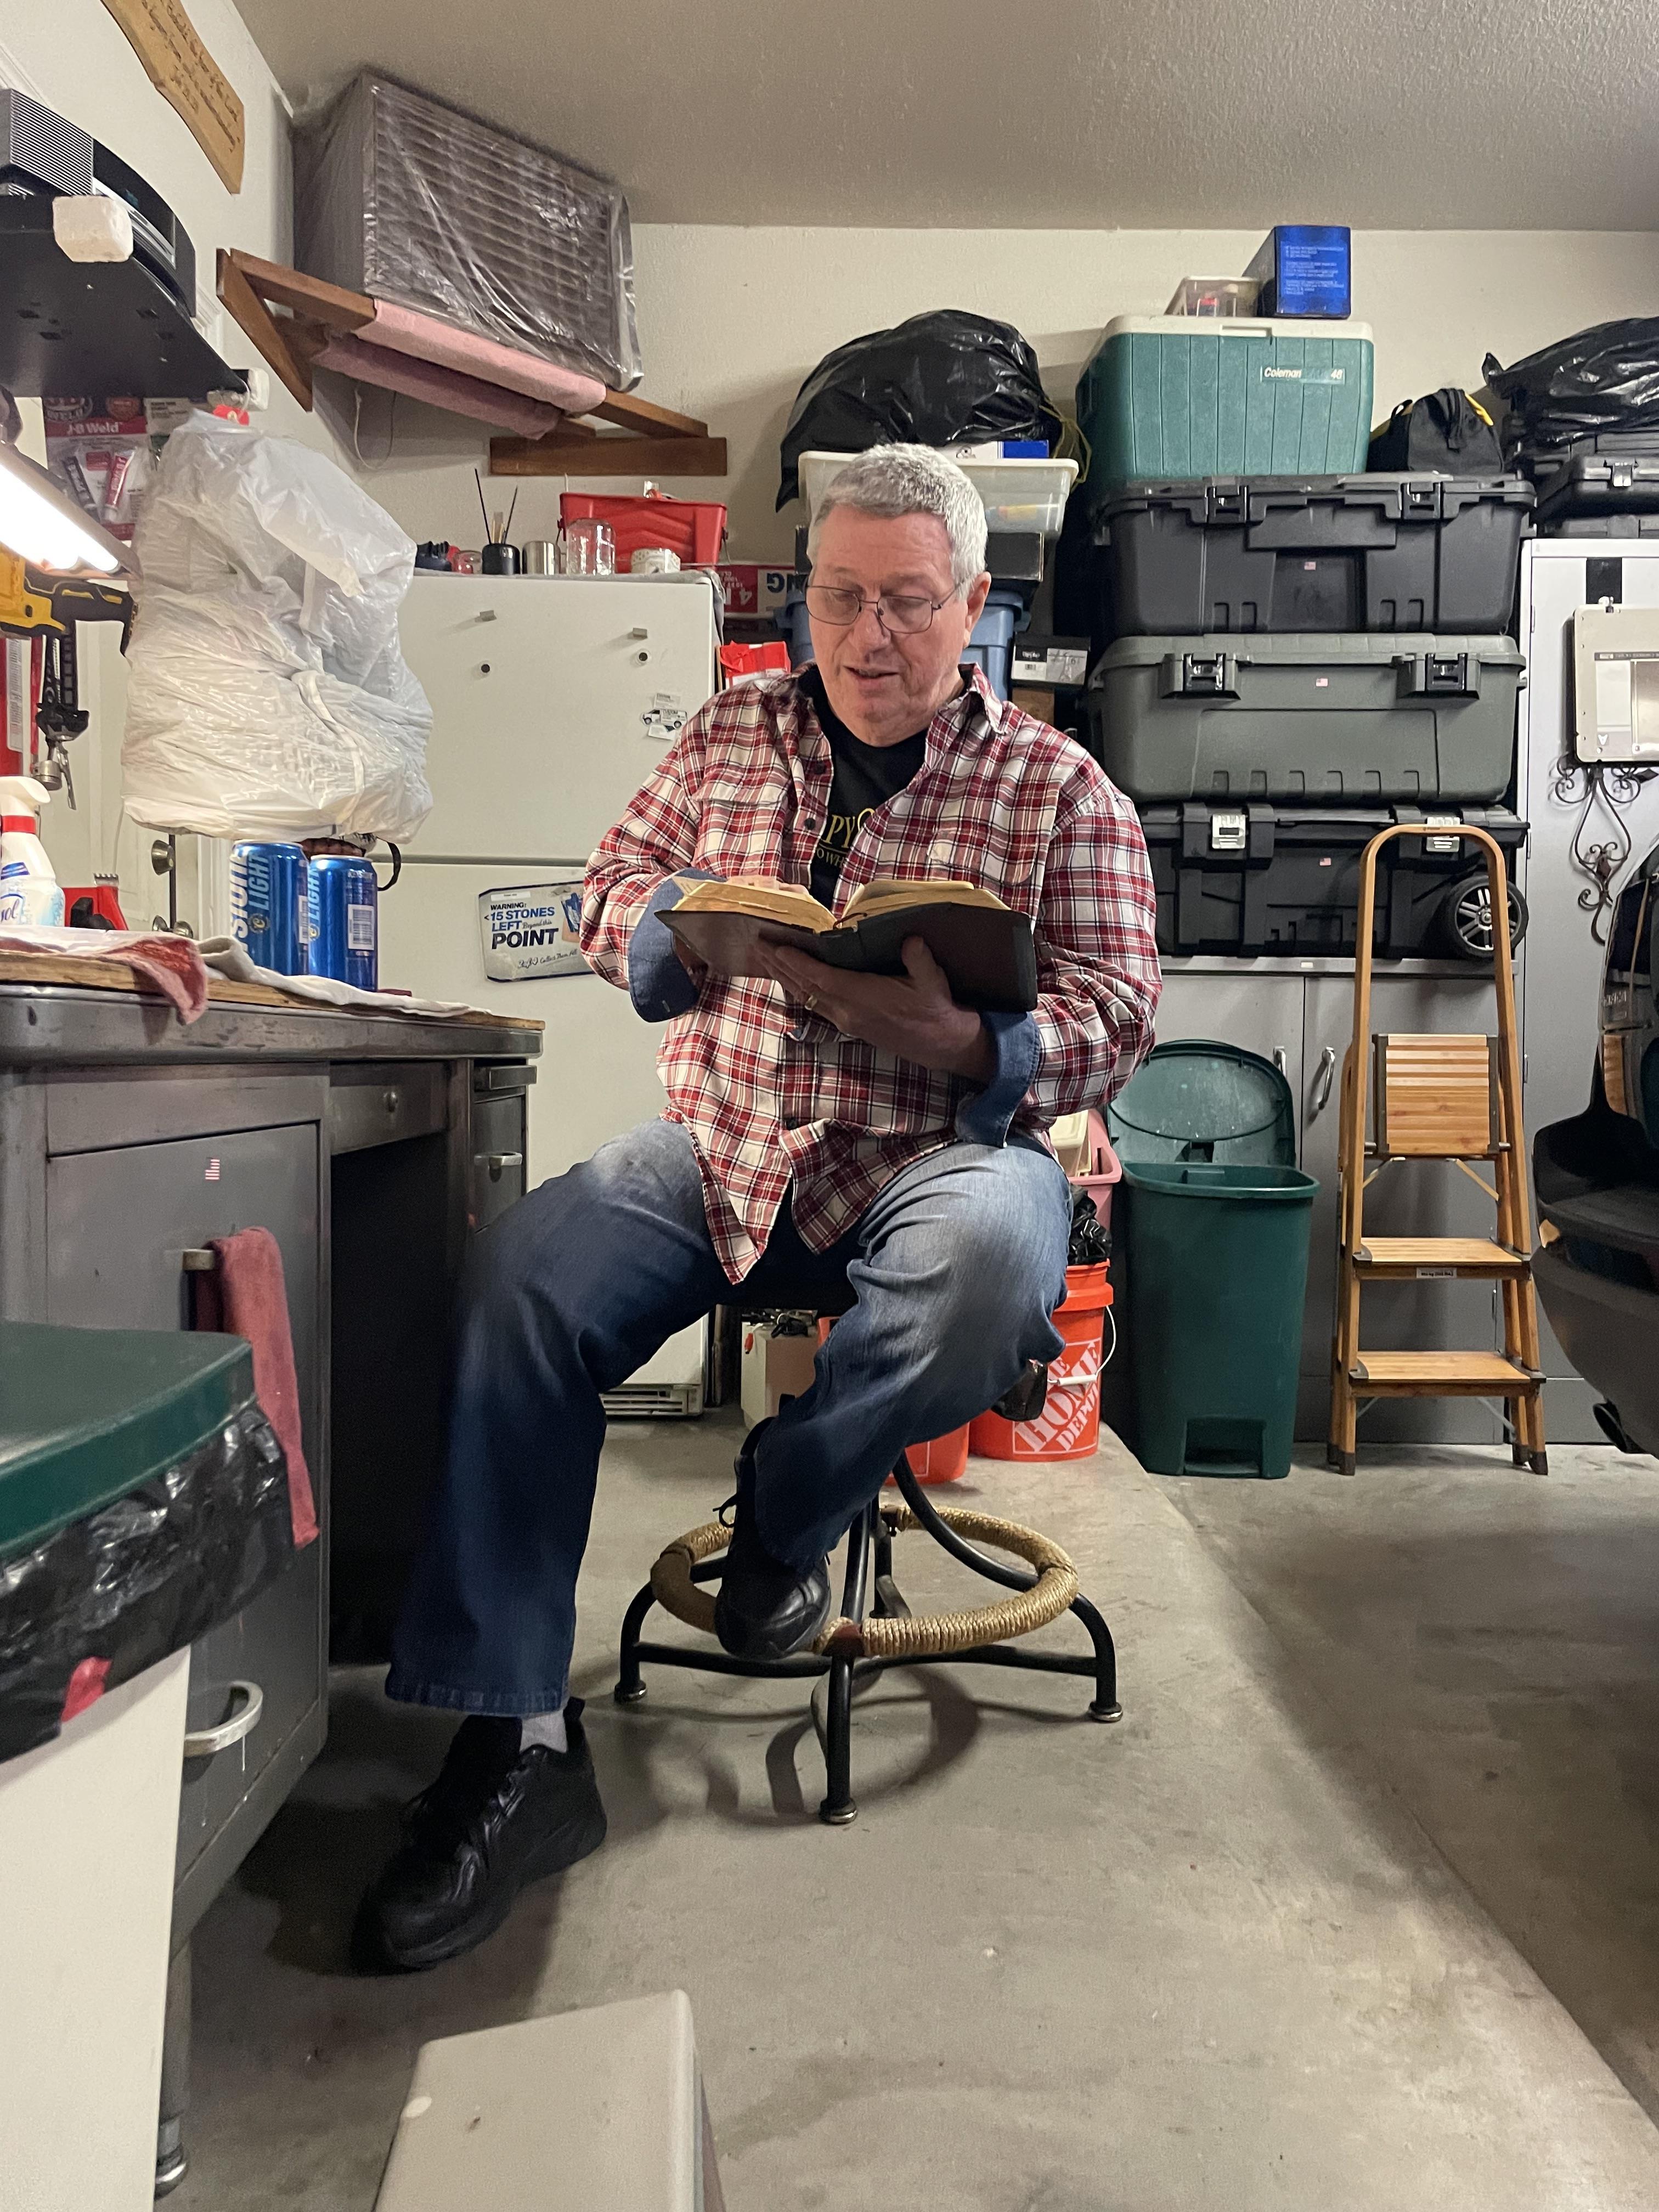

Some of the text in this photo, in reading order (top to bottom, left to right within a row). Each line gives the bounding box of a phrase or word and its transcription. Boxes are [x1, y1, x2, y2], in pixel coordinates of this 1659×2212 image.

[1264, 366, 1302, 378] Coleman
[86, 421, 119, 433] Weld
[767, 573, 808, 594] NG
[248, 854, 270, 911] LIGHT
[490, 902, 527, 911] WARNING:
[490, 907, 555, 921] 15 STONES
[492, 920, 522, 932] LEFT
[492, 928, 559, 950] POINT
[1015, 1342, 1100, 1452] HOME
